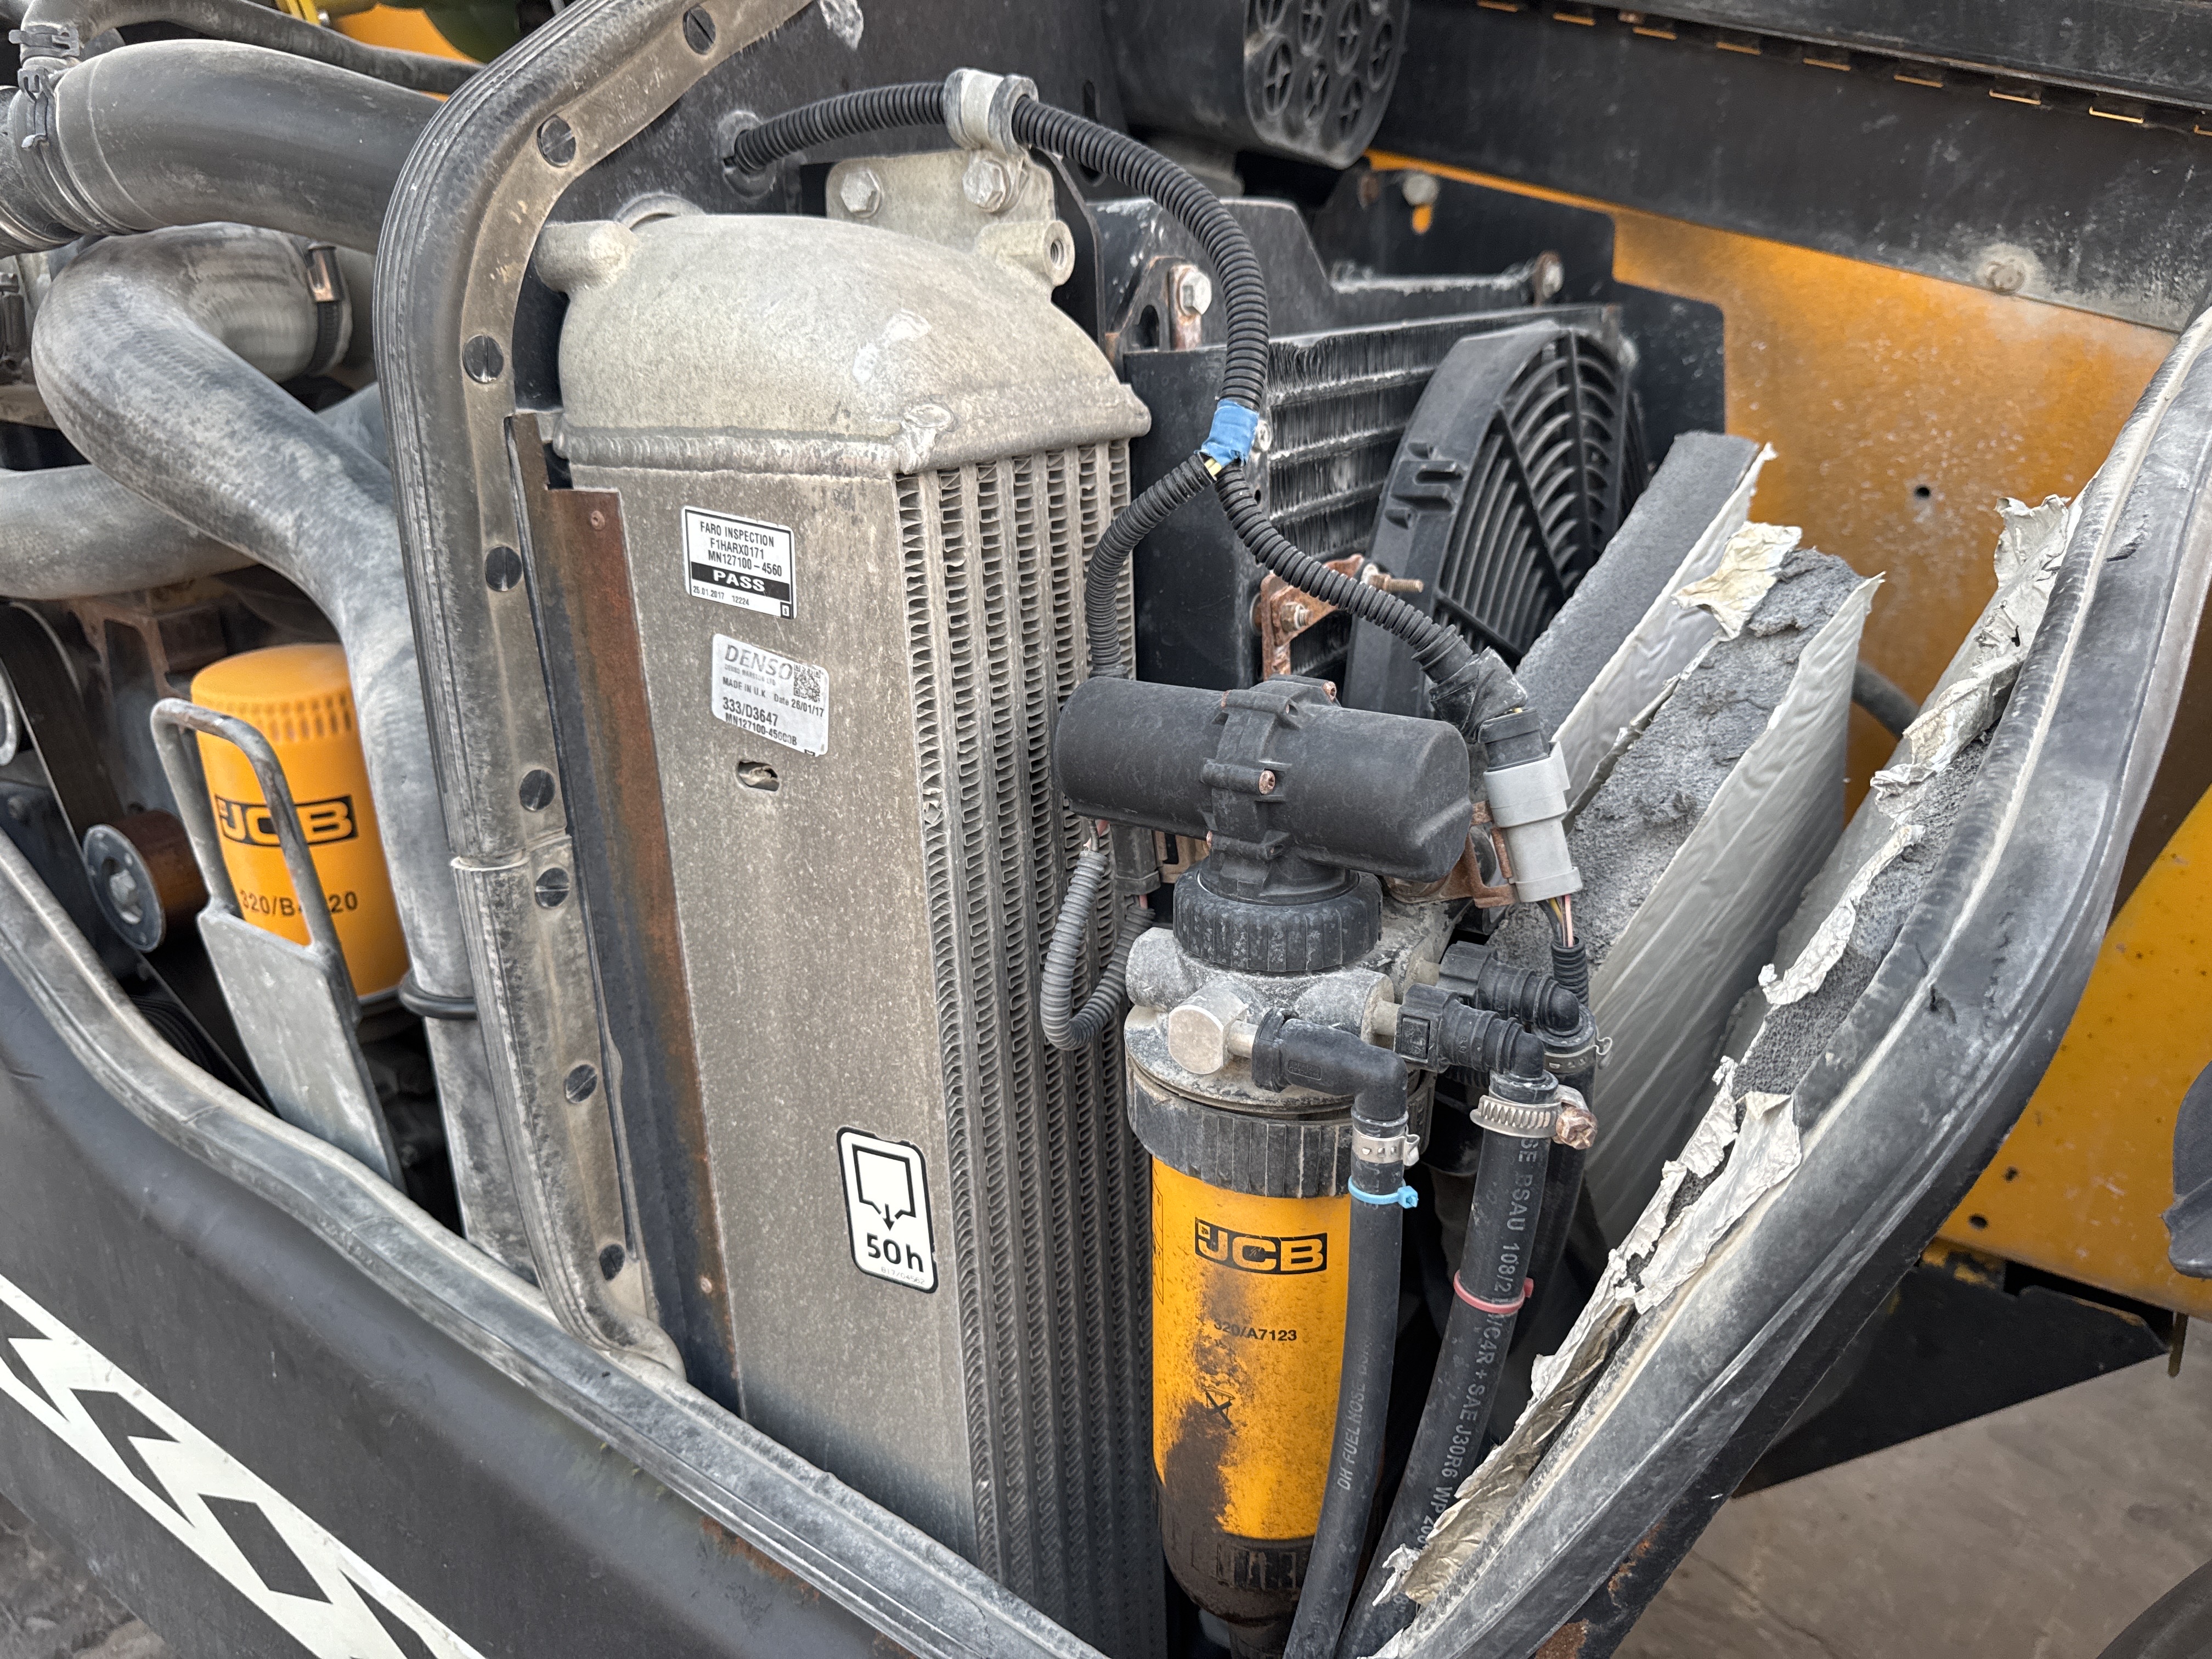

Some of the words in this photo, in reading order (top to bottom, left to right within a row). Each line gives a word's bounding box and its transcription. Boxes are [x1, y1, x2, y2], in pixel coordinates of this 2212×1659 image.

[700, 521, 721, 537] FARO
[725, 527, 775, 548] INSPECTION
[710, 538, 764, 560] F1HARX0171
[693, 586, 725, 600] 25.01.2017
[732, 595, 750, 606] 12224
[714, 570, 765, 592] PASS
[725, 644, 793, 680] DENSO
[723, 676, 743, 691] MADE
[744, 684, 753, 694] IN
[774, 694, 789, 707] Date
[791, 698, 824, 718] 26/01/17
[723, 697, 778, 727] 333/D3647
[219, 799, 353, 845] JCB
[1198, 1223, 1324, 1272] JCB
[1493, 1243, 1521, 1293] 108/2
[1214, 1318, 1297, 1341] 320/A7123
[1348, 1379, 1367, 1425] HOSE
[1459, 1383, 1486, 1421] SAE
[1342, 1425, 1361, 1465] FUEL
[1441, 1424, 1472, 1478] J30R6
[1430, 1486, 1453, 1514] WP
